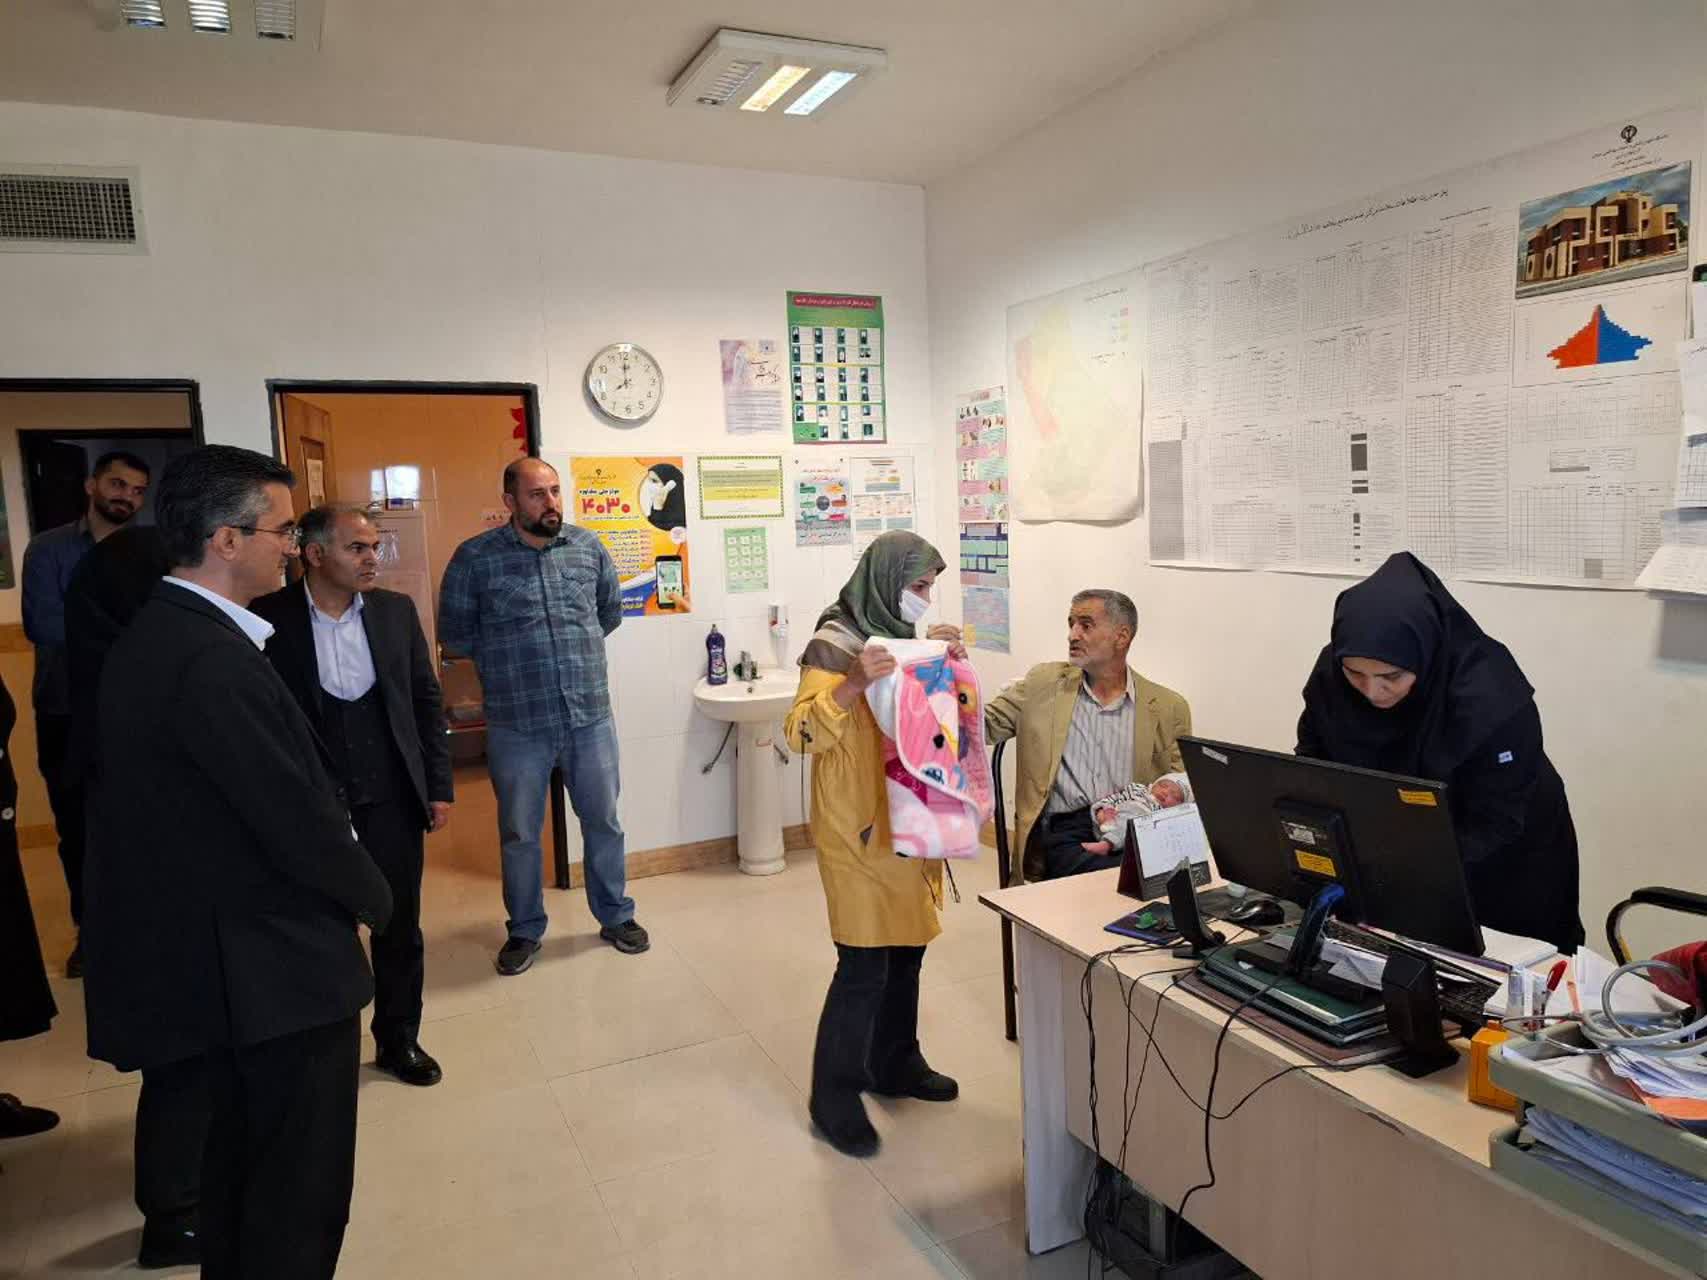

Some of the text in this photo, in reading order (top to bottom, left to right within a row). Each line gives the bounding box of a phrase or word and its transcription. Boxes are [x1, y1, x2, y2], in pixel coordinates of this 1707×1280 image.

[618, 352, 629, 361] 12
[625, 404, 632, 414] 6
[638, 400, 645, 410] 5
[581, 497, 631, 515] ۴۰۳۰
